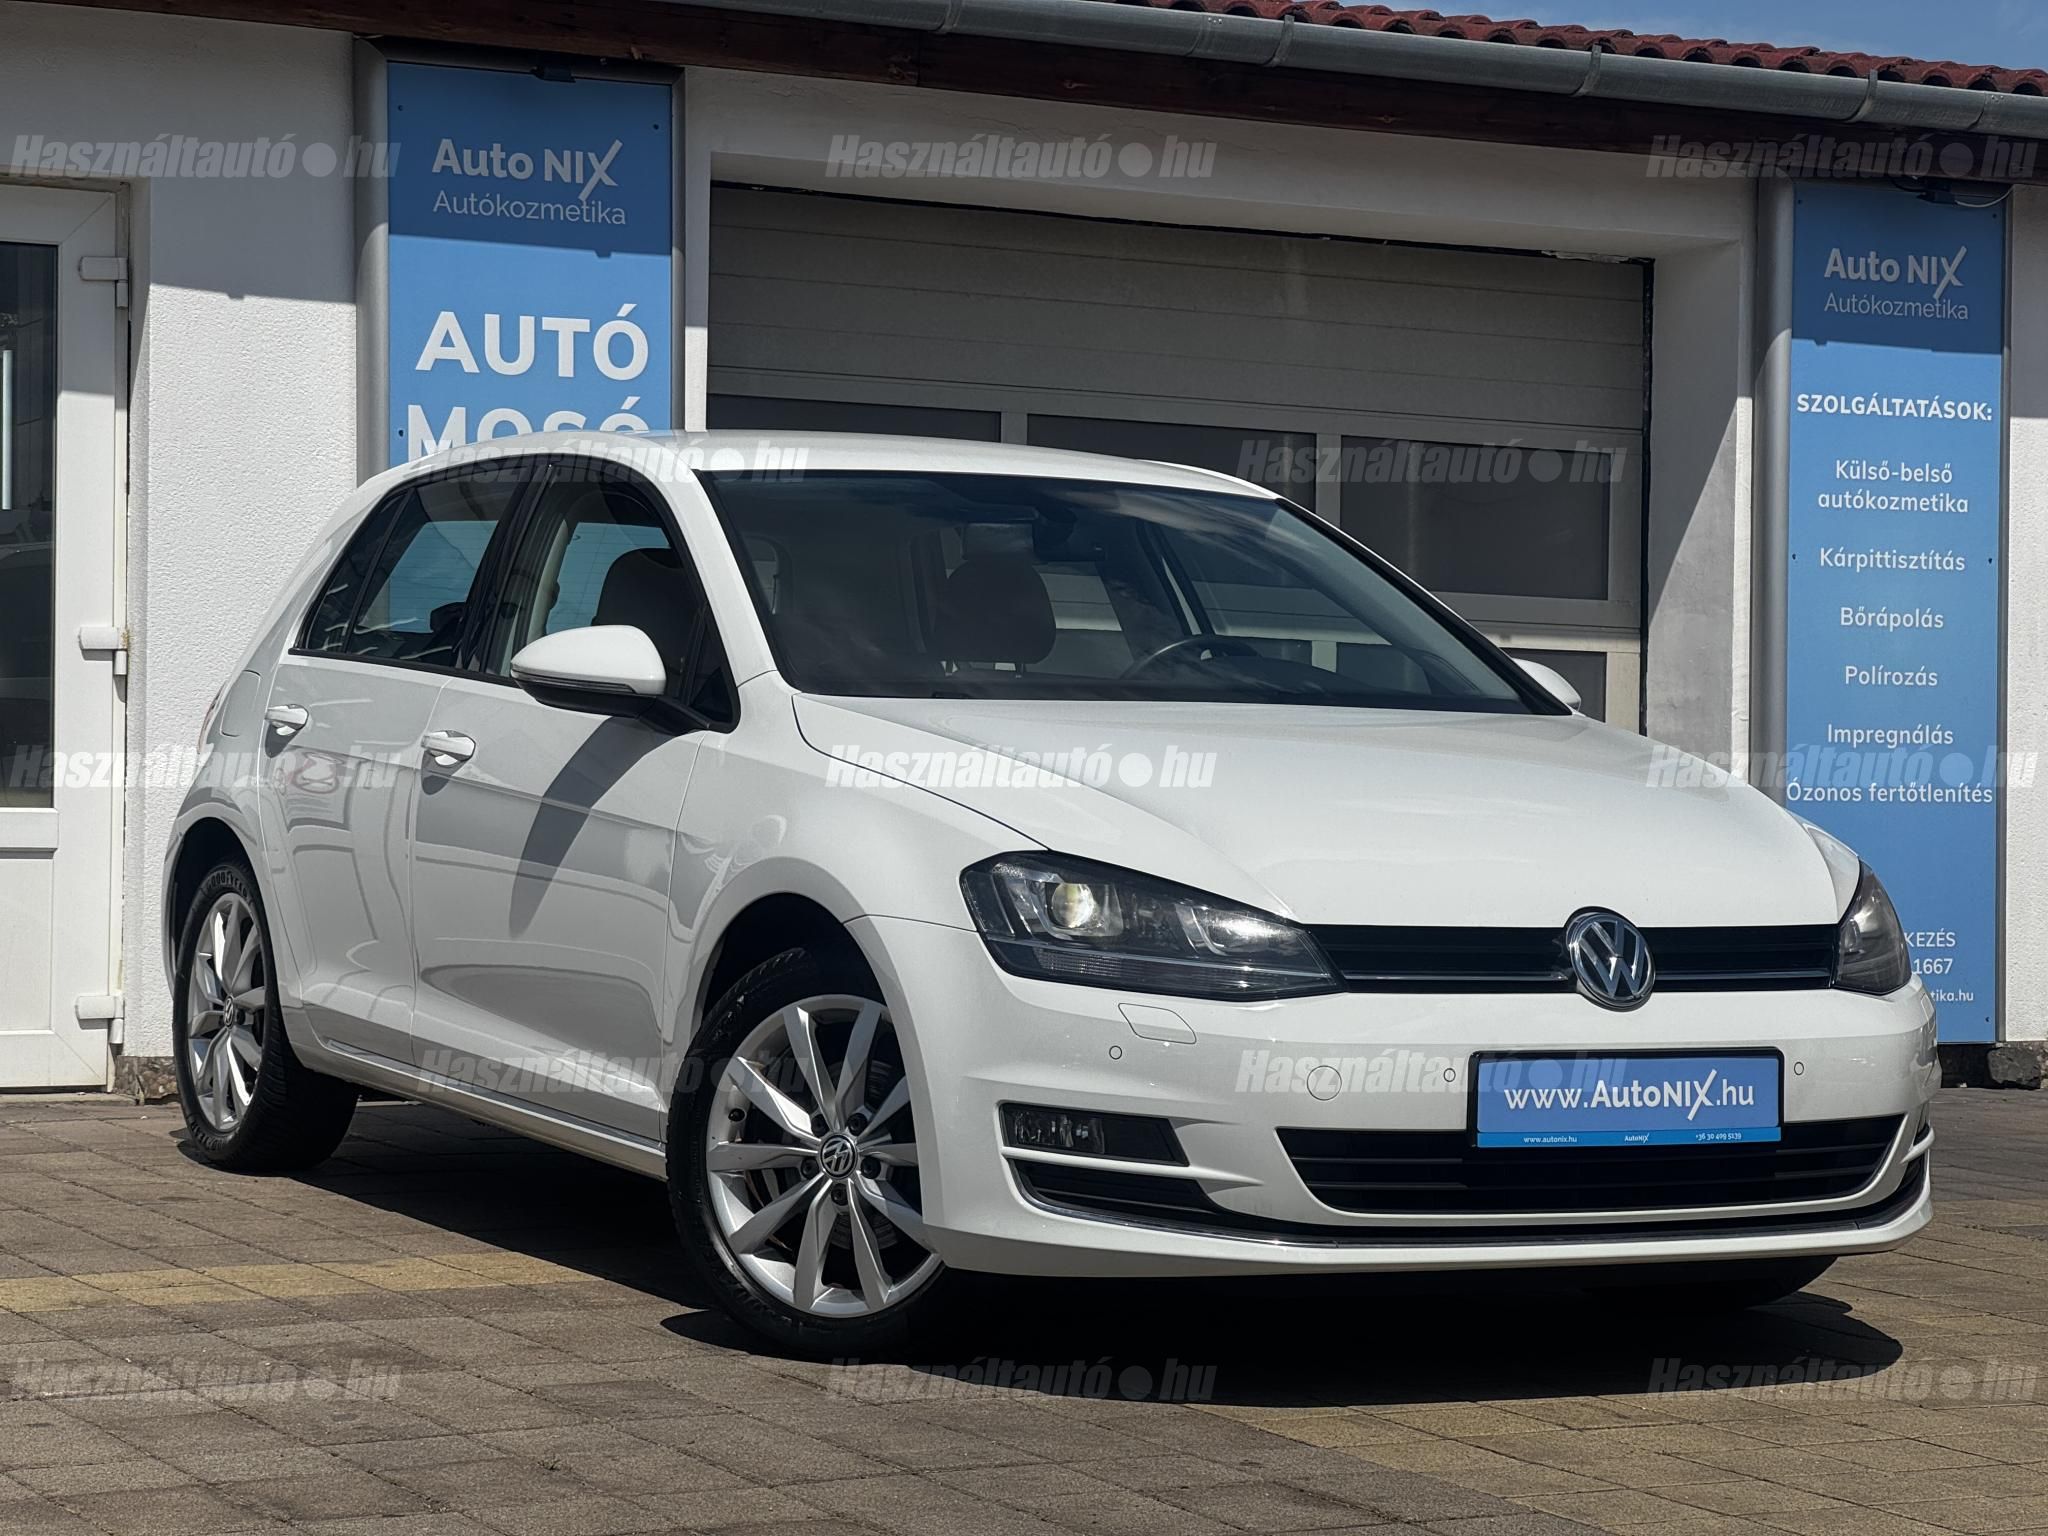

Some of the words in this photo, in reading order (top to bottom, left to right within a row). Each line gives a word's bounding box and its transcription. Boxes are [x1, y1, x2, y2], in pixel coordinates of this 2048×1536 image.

[432, 138, 534, 180] Auto
[544, 139, 623, 201] NIX
[433, 190, 626, 225] Autókozmetika
[1824, 247, 1900, 283] Auto
[1907, 246, 1967, 300] NIX
[1824, 292, 1969, 320] Autókozmetika
[415, 303, 649, 381] AUTÓ
[1797, 392, 1993, 422] SZOLGÁLTATÁSOK:
[1835, 459, 1953, 484] Külső-belső
[1818, 490, 1969, 513] autókozmetika
[1820, 547, 1966, 573] Kárpittisztítás
[1840, 606, 1944, 632] Bőrápolás
[1844, 665, 1938, 687] Polírozás
[1827, 723, 1954, 749] Impregnálás
[1786, 780, 1862, 802] Ózonos
[1868, 781, 1993, 803] fertőtlenítés
[1912, 958, 1953, 974] 1667
[1504, 1069, 1754, 1121] www.AutoNIX.hu
[1523, 1135, 1578, 1143] www.autonix.hu
